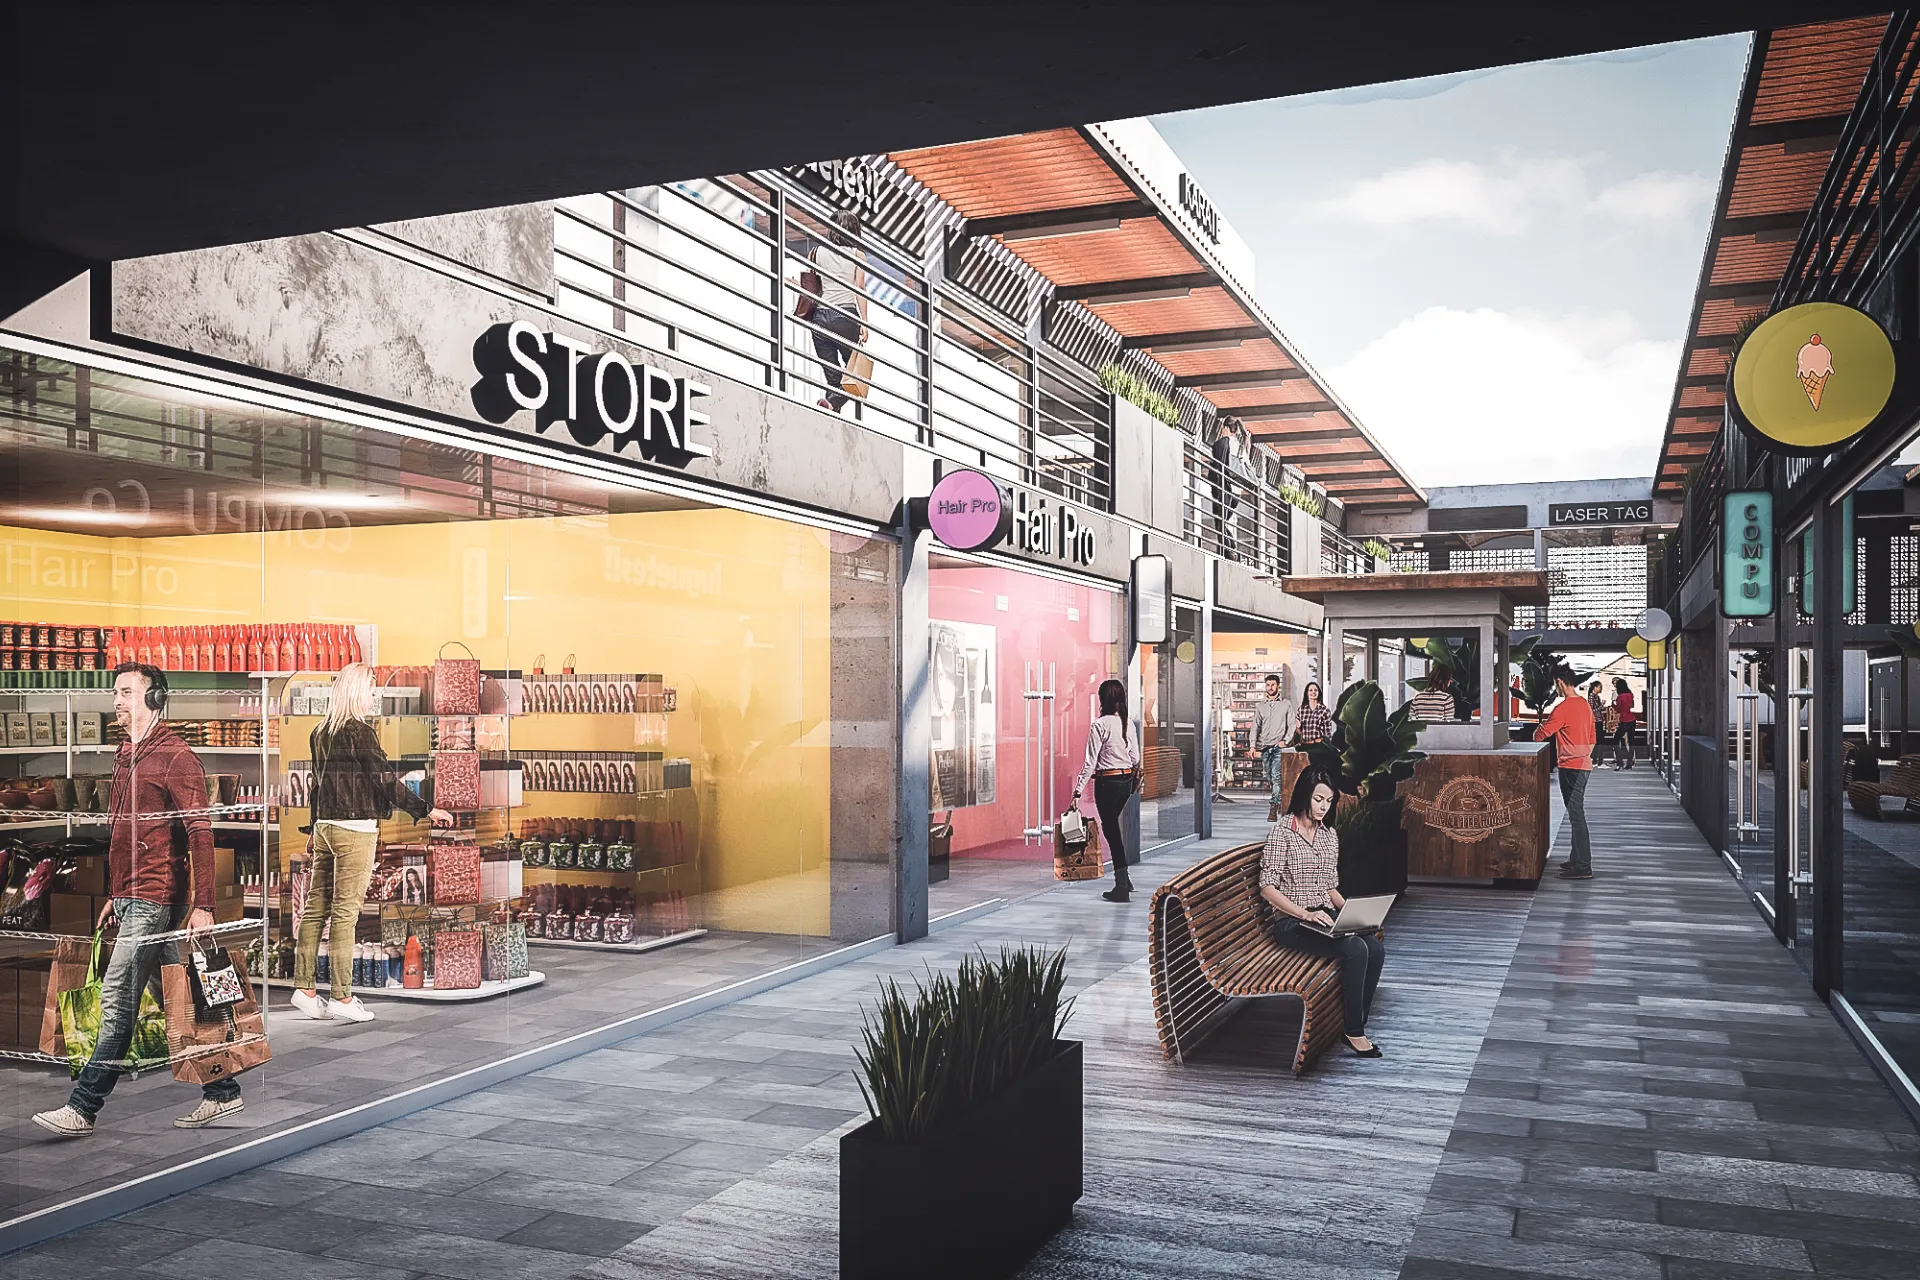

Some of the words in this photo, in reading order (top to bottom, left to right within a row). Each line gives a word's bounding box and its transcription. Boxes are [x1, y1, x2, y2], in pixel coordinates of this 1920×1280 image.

[506, 320, 713, 457] STORE
[937, 500, 967, 514] Hair
[970, 498, 997, 513] Pro
[1012, 487, 1058, 555] Hair
[1063, 505, 1097, 566] Pro
[1555, 507, 1609, 522] LASER
[1614, 505, 1649, 520] TAG
[5, 543, 97, 590] Hair
[111, 553, 179, 595] Pro
[1742, 503, 1762, 599] COMPU
